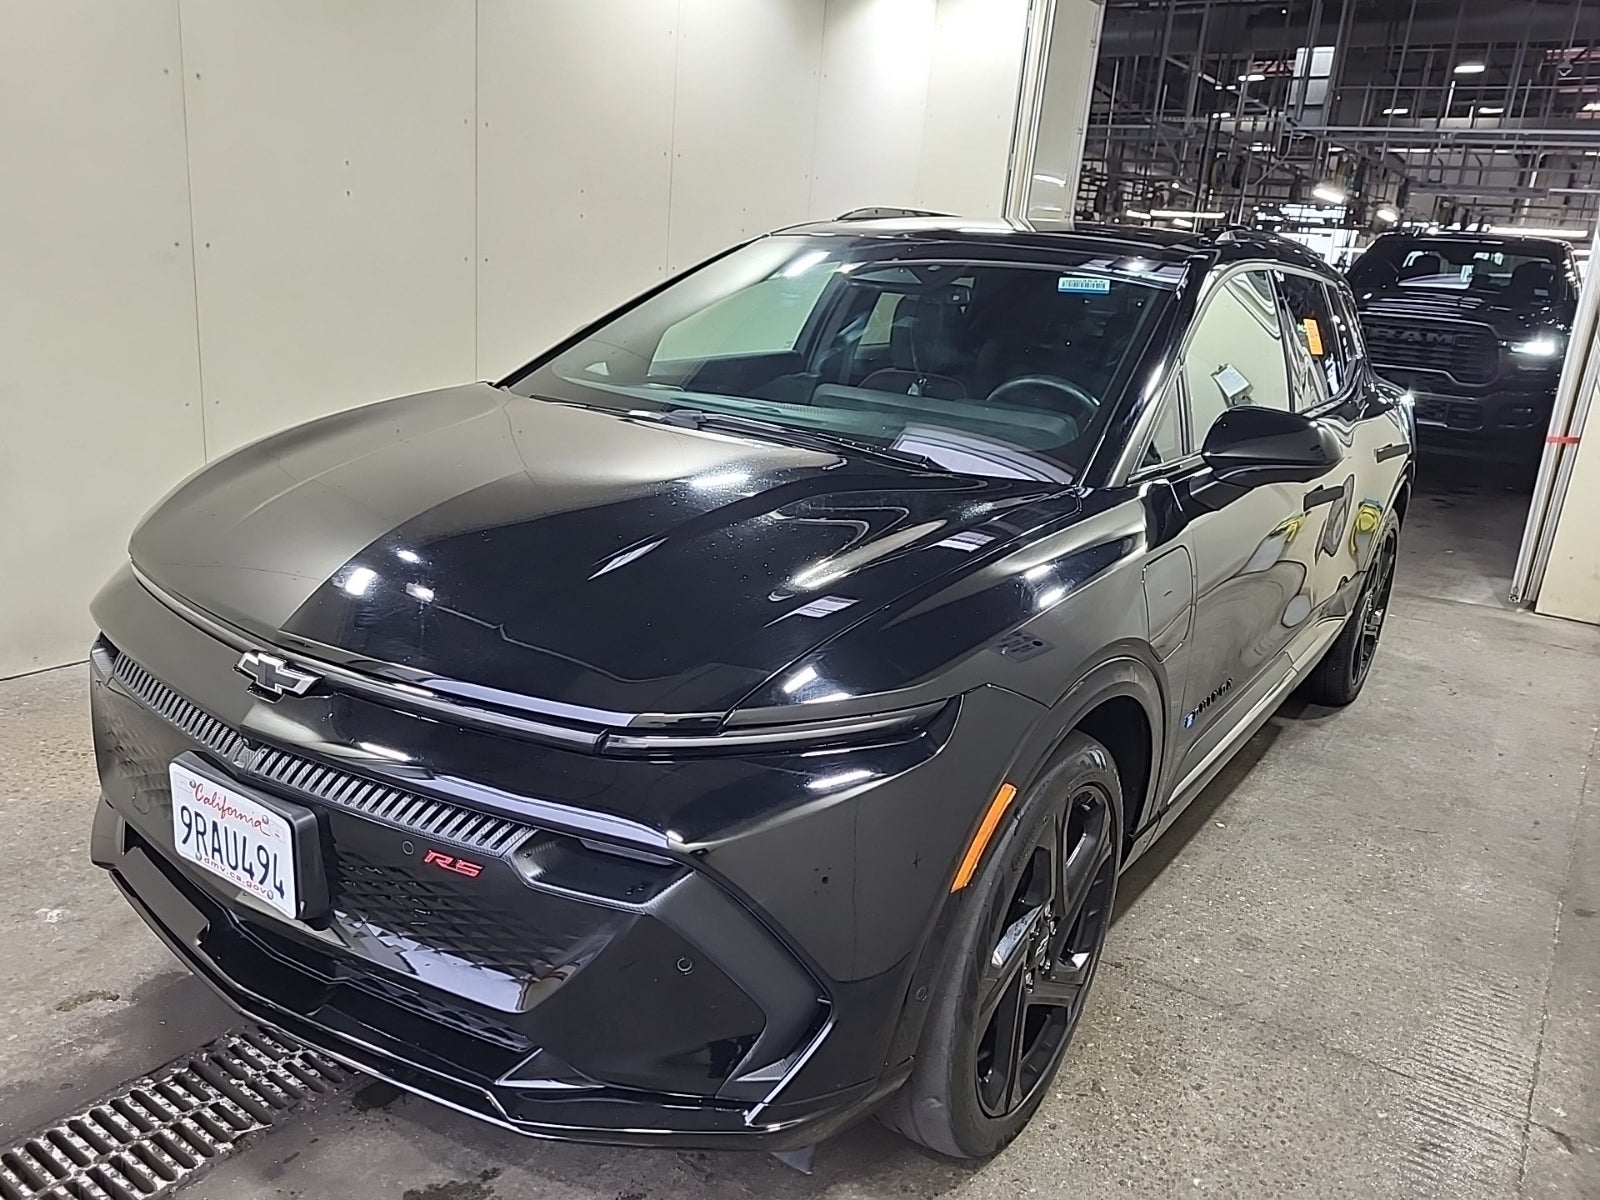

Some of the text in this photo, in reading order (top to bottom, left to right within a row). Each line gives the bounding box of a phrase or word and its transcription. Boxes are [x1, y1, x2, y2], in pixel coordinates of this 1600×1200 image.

[1374, 328, 1454, 344] RAM
[194, 783, 270, 836] California
[180, 805, 285, 899] 9RAU494
[424, 850, 484, 877] RS
[204, 857, 268, 896] dmv.ca.gov
